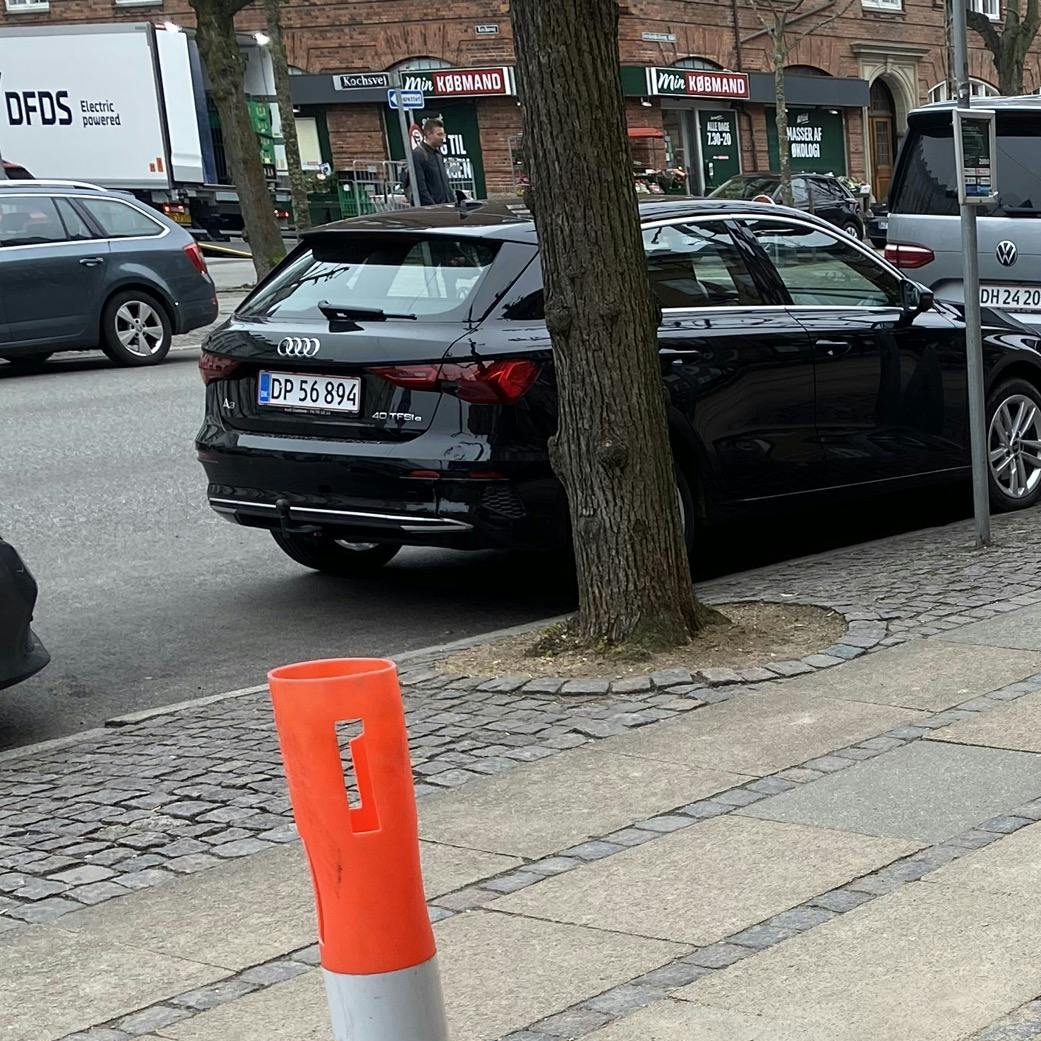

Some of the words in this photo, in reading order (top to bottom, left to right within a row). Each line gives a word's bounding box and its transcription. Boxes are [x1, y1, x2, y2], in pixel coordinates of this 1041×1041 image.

[405, 75, 434, 91] Min
[436, 73, 502, 94] KØBMAND
[657, 72, 686, 91] Min
[688, 75, 746, 94] KØBMAND
[4, 90, 73, 126] DFDS
[80, 99, 115, 113] Electric
[82, 113, 121, 128] powered
[447, 134, 467, 155] TIL
[981, 288, 1000, 304] DH
[1002, 289, 1021, 306] 24
[271, 378, 294, 400] DP
[299, 380, 320, 402] 56
[324, 381, 357, 406] 894
[372, 412, 387, 420] 40
